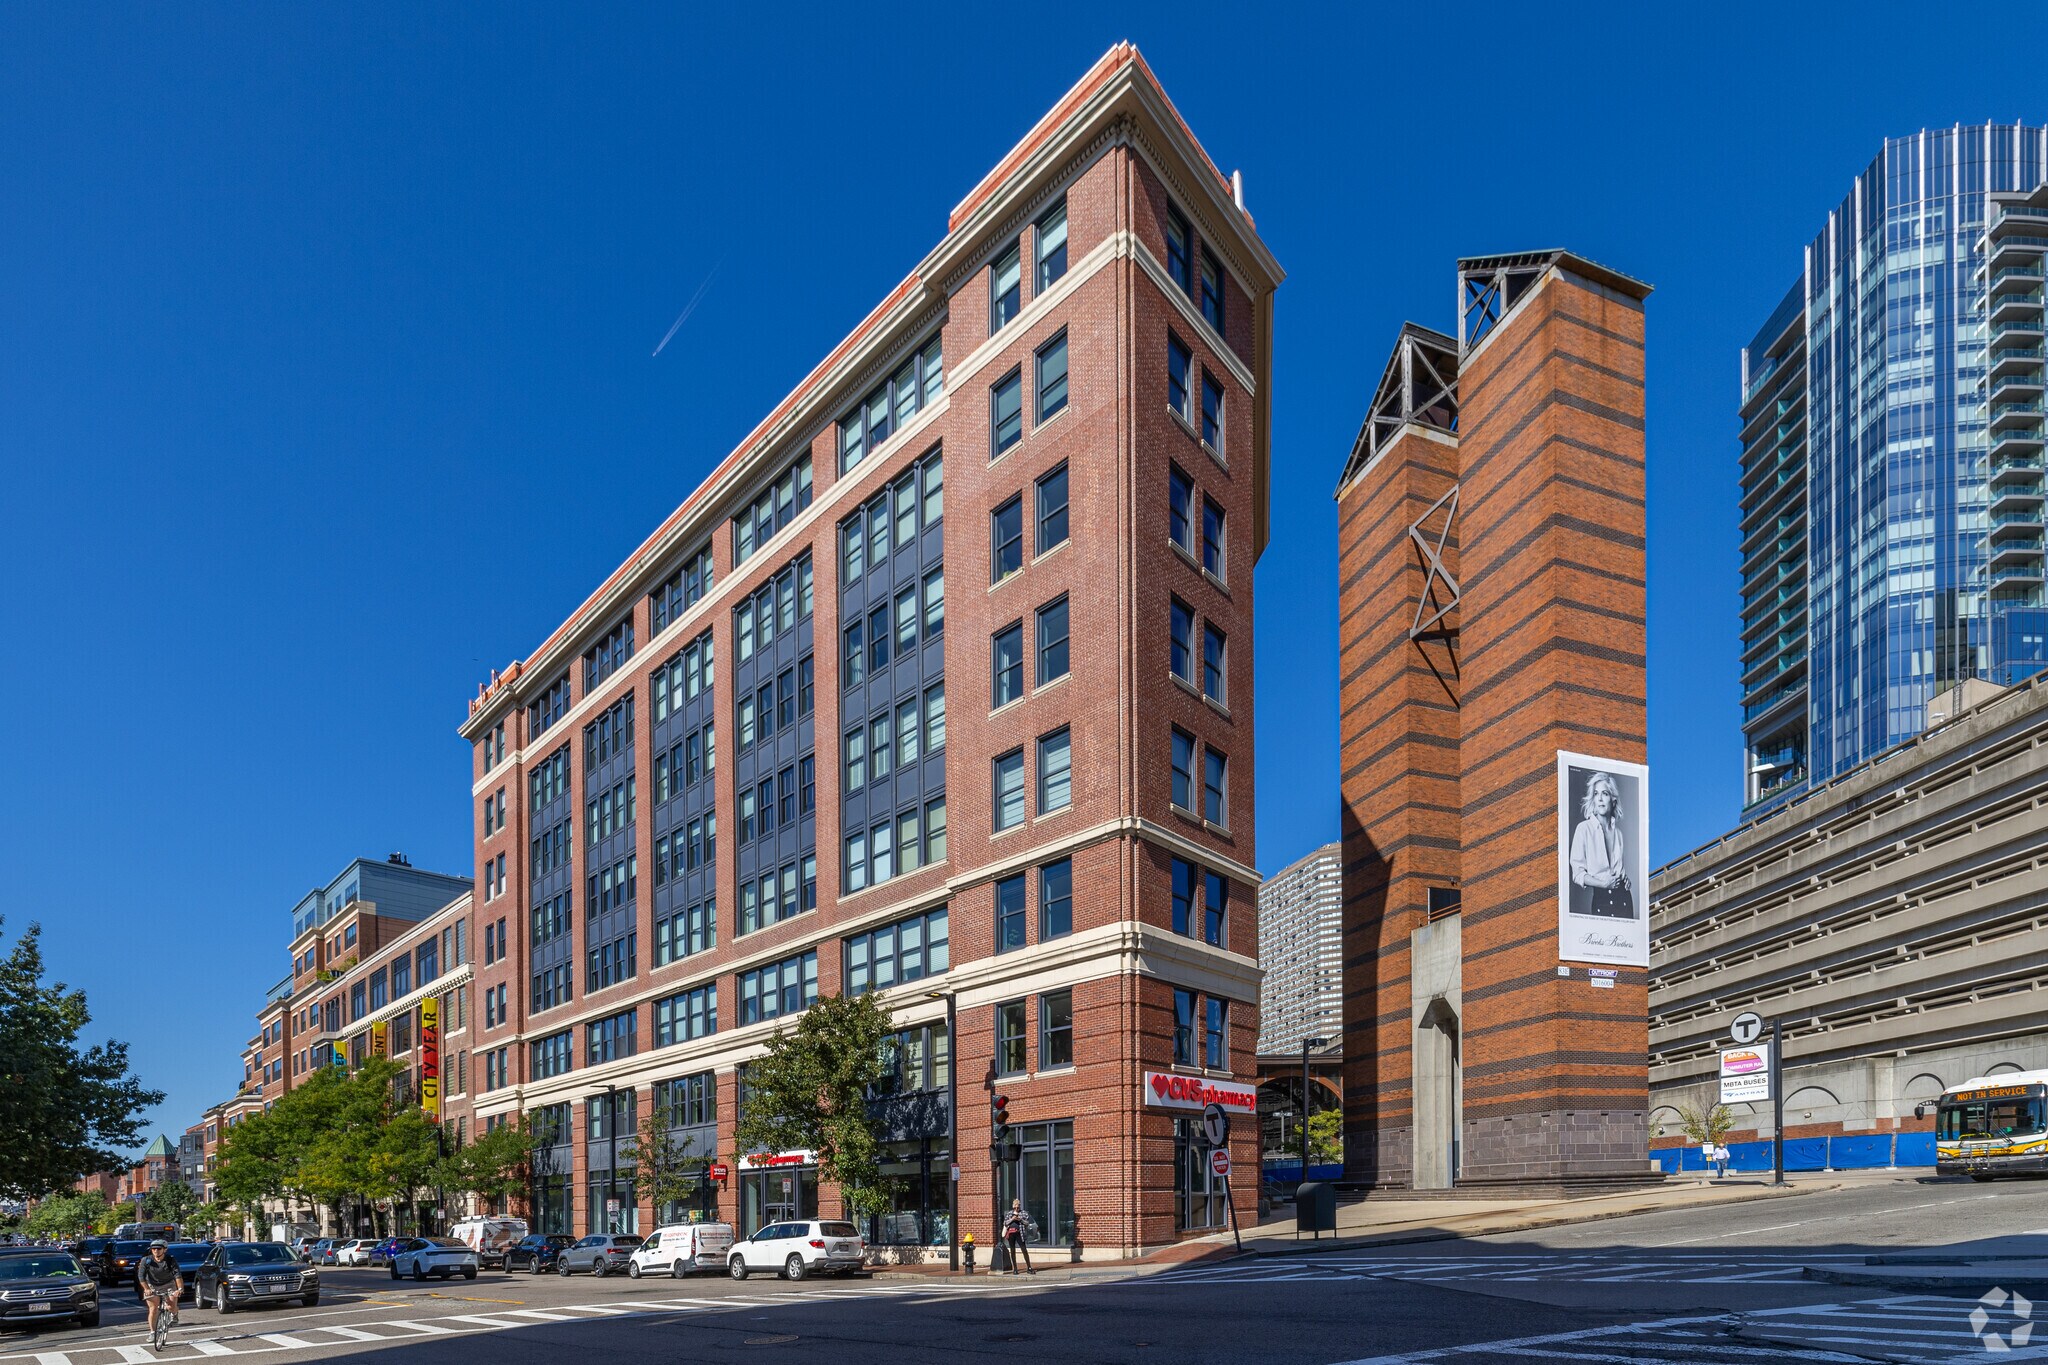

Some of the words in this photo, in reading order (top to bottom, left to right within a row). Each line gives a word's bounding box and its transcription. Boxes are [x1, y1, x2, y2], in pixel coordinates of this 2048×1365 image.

[1579, 932, 1604, 946] Brooks
[1605, 934, 1634, 949] Brothers
[423, 1012, 437, 1055] YEAR
[1736, 1019, 1756, 1038] T
[423, 1061, 438, 1098] CITY
[1743, 1078, 1767, 1086] BUSES
[1169, 1076, 1203, 1102] CVS
[1203, 1085, 1257, 1111] pharmacy
[1956, 1092, 1973, 1101] NOT
[1975, 1090, 1987, 1099] IN
[1989, 1086, 2027, 1098] SERVICE
[1206, 1113, 1218, 1136] T
